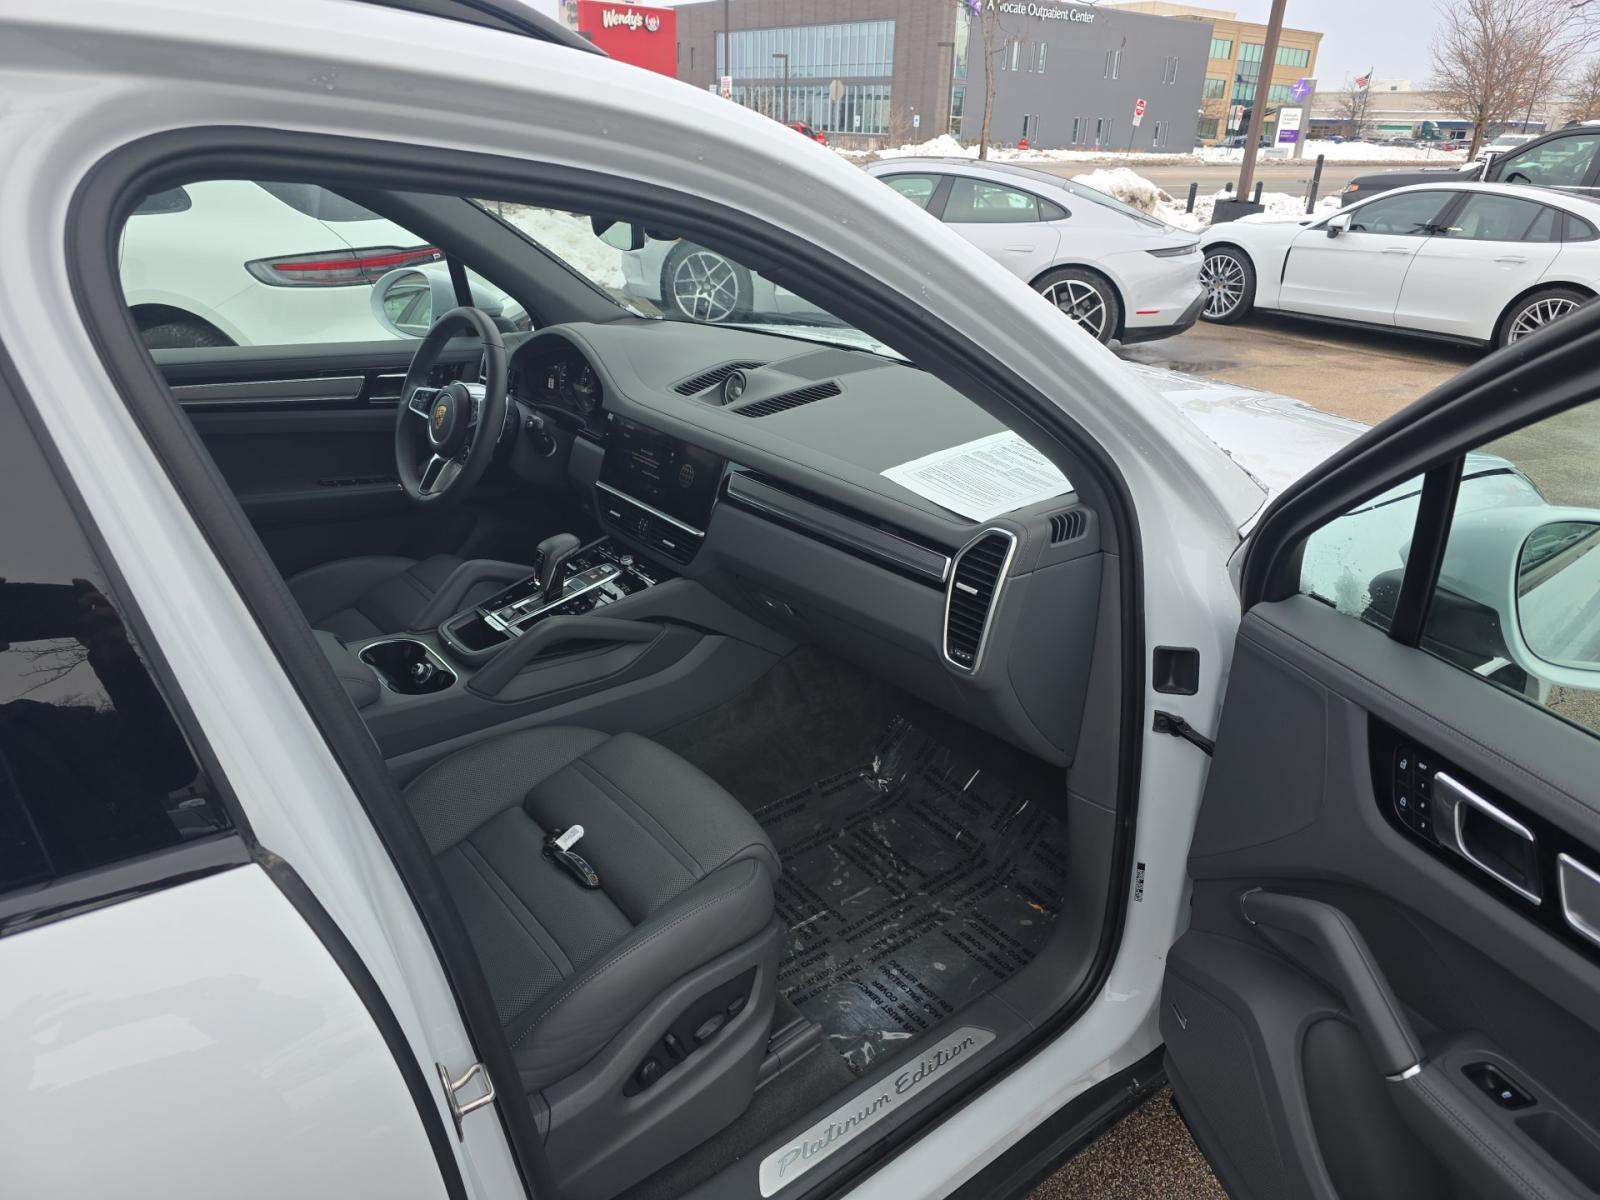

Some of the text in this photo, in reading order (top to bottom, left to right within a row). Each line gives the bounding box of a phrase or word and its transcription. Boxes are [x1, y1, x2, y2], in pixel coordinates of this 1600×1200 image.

[603, 9, 643, 31] Wendy's
[987, 0, 1095, 23] Avocate Outpatient Center
[871, 978, 898, 1003] COVER
[887, 957, 918, 984] DEALER
[915, 980, 939, 1001] MUST
[880, 1002, 905, 1025] MUST
[778, 1035, 975, 1177] Platinum Edition
